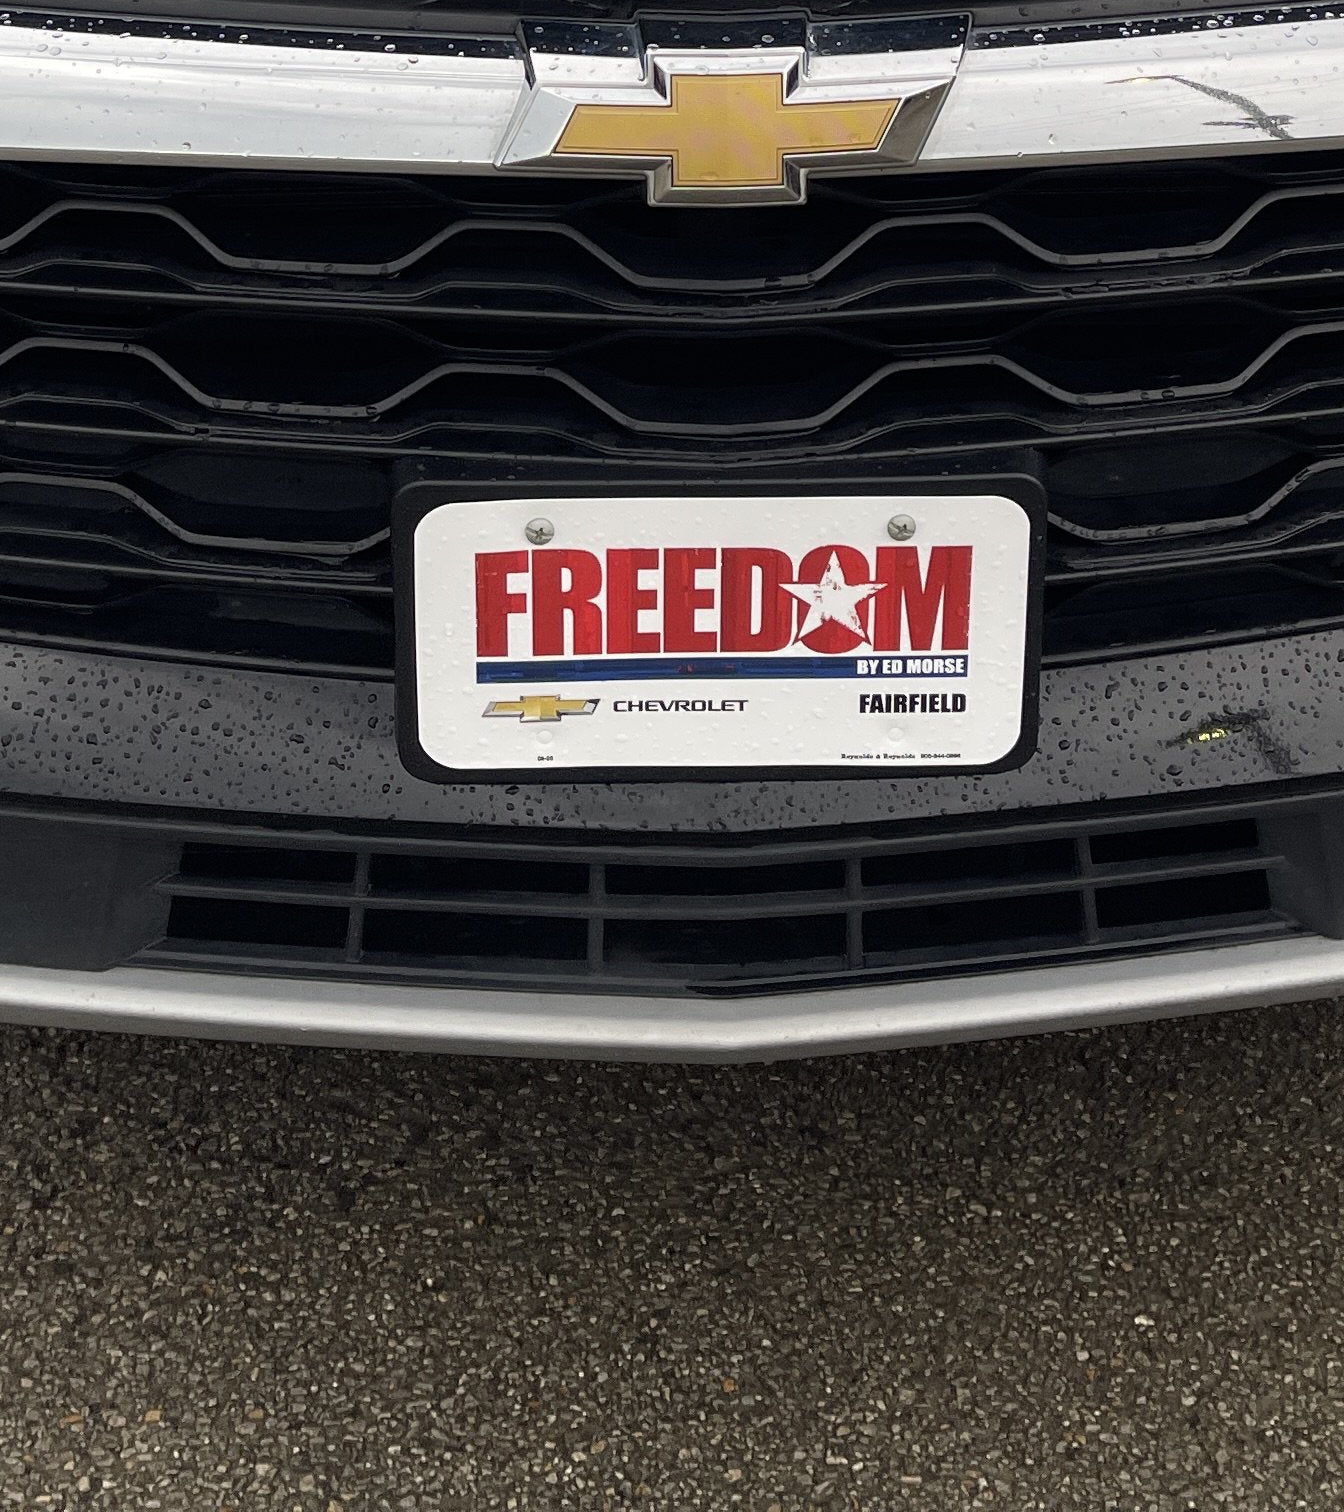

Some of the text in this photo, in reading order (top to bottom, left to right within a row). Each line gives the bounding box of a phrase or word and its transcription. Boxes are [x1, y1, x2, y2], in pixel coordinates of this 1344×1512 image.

[474, 544, 973, 657] FREEDOM
[856, 658, 965, 675] BY ED MORSE
[613, 699, 749, 712] CHEVROLET
[859, 693, 967, 714] FAIRFIELD
